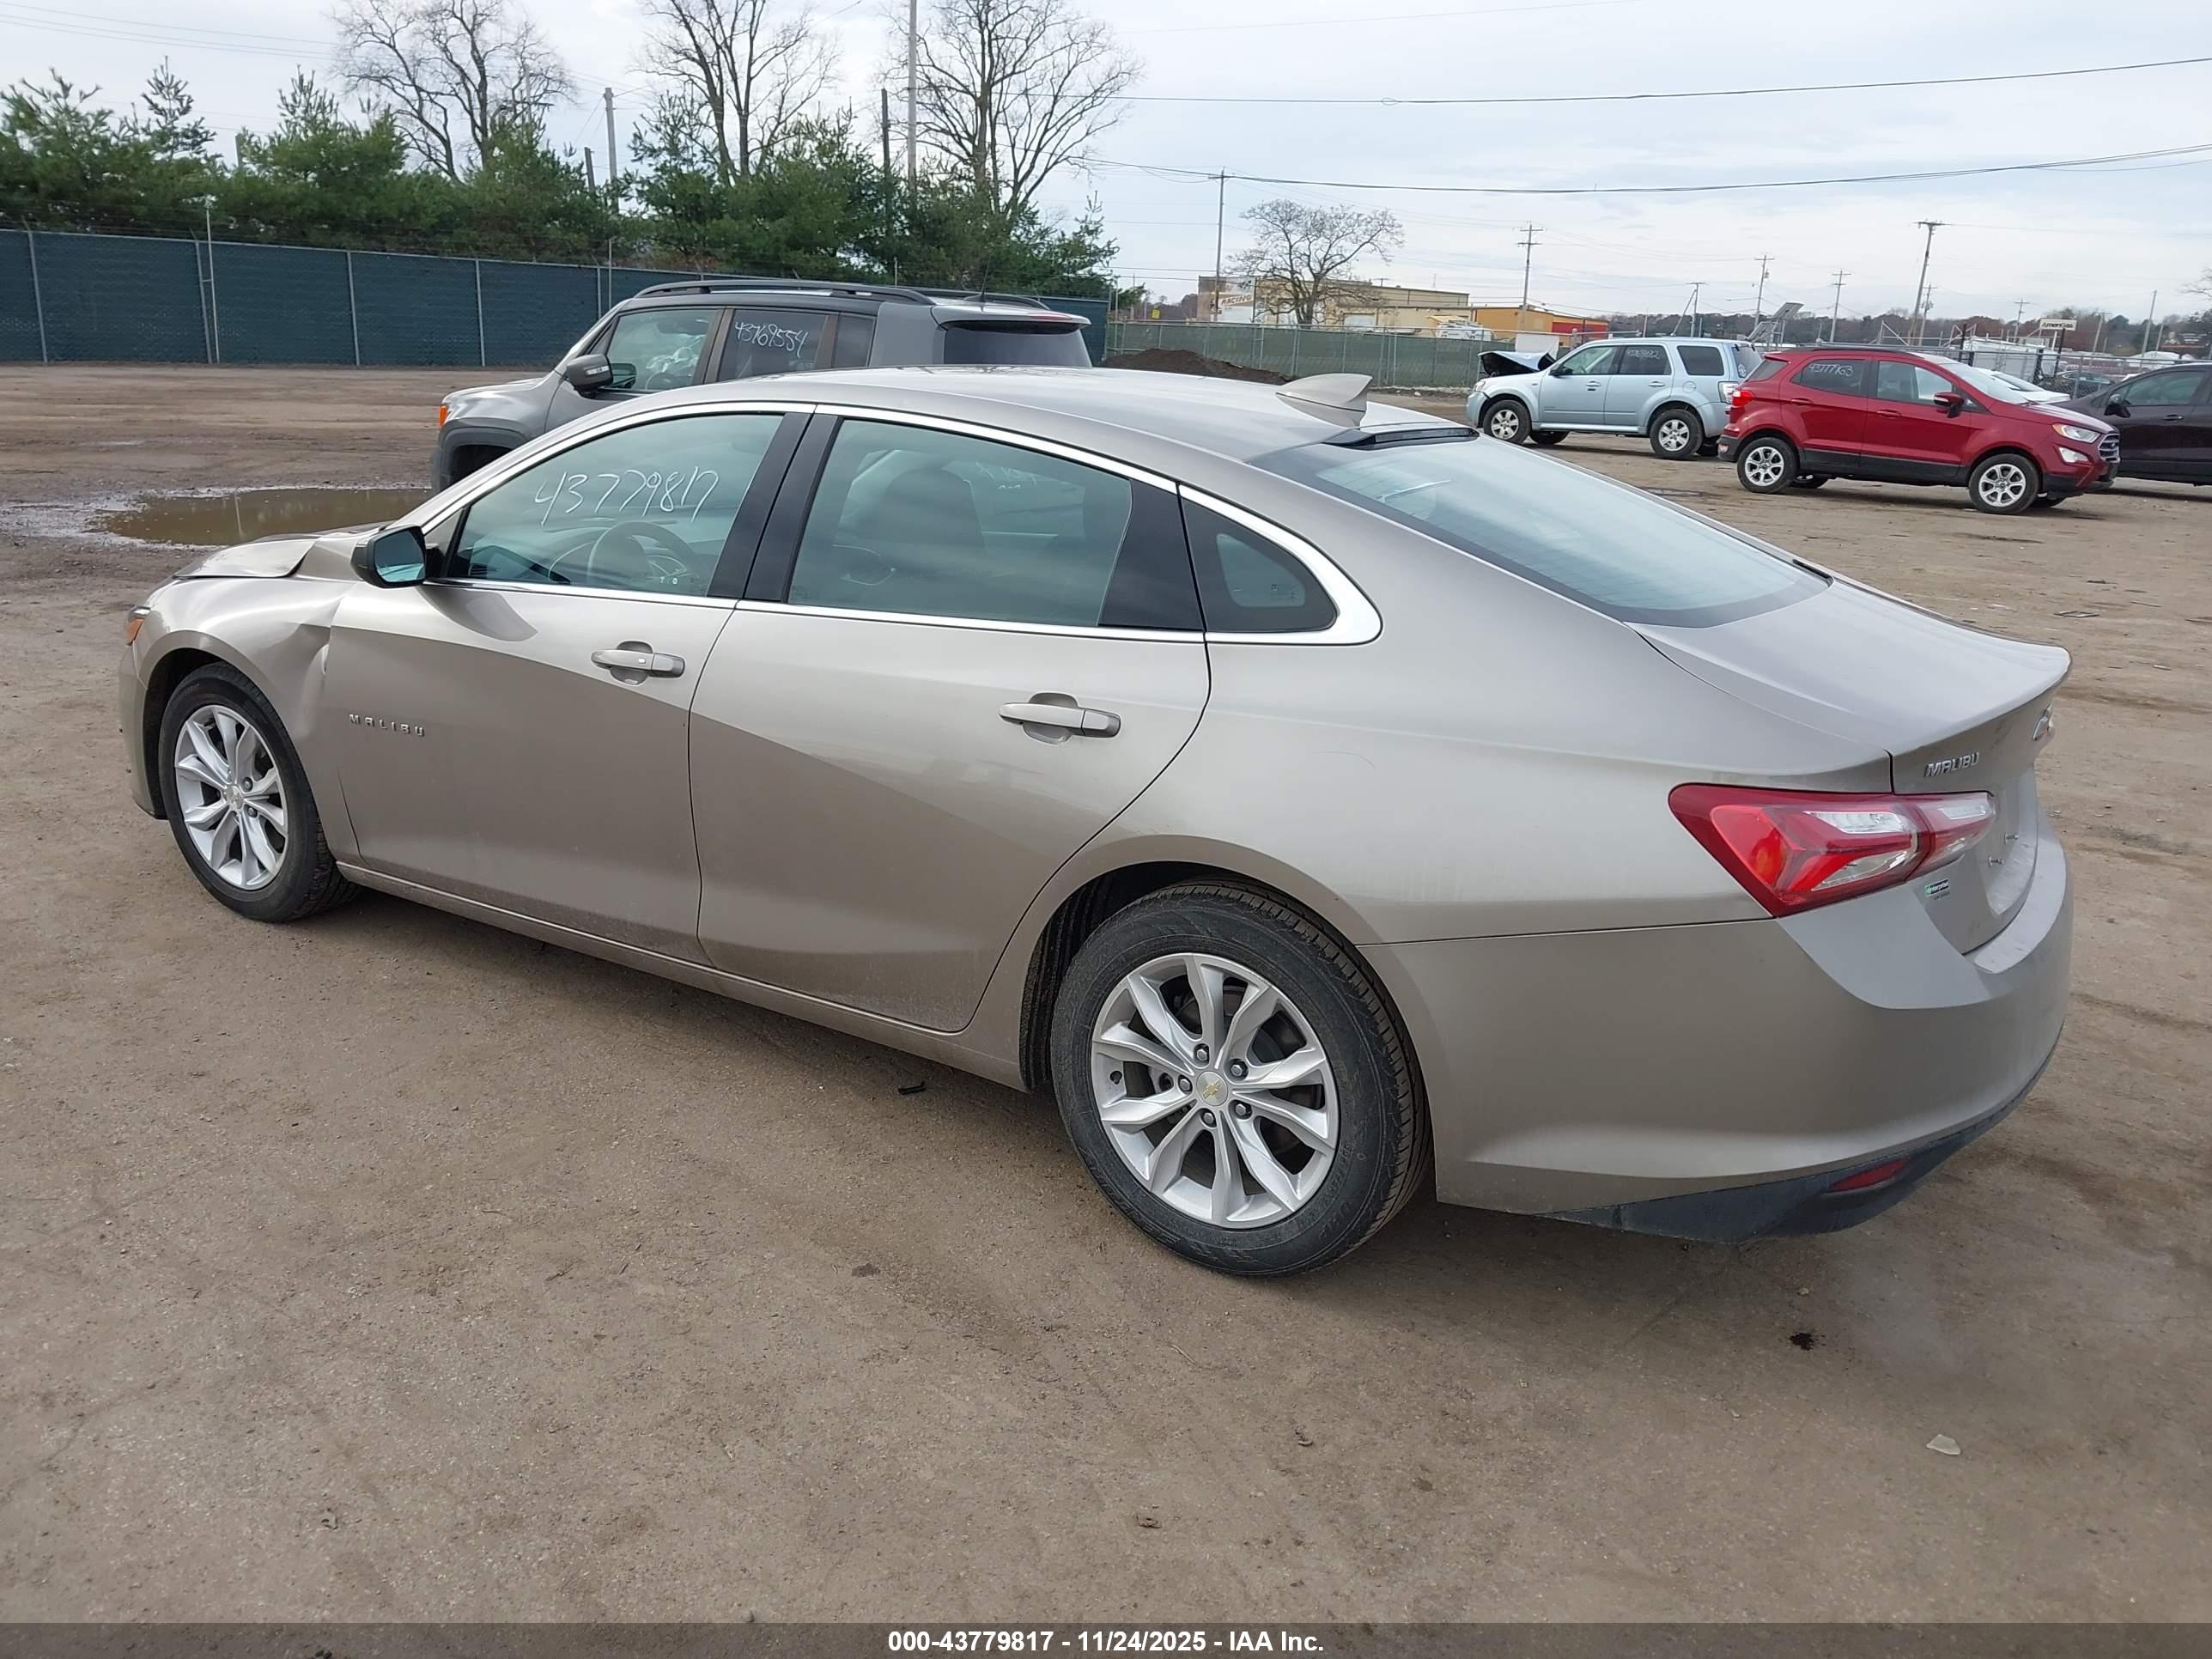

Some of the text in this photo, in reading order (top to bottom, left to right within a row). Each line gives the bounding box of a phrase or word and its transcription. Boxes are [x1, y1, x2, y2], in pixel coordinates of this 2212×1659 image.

[1221, 294, 1252, 306] RACING
[735, 322, 809, 358] 43769554
[534, 466, 720, 527] 43779817
[349, 714, 425, 737] MALIBU
[1923, 751, 1979, 777] MALIBU
